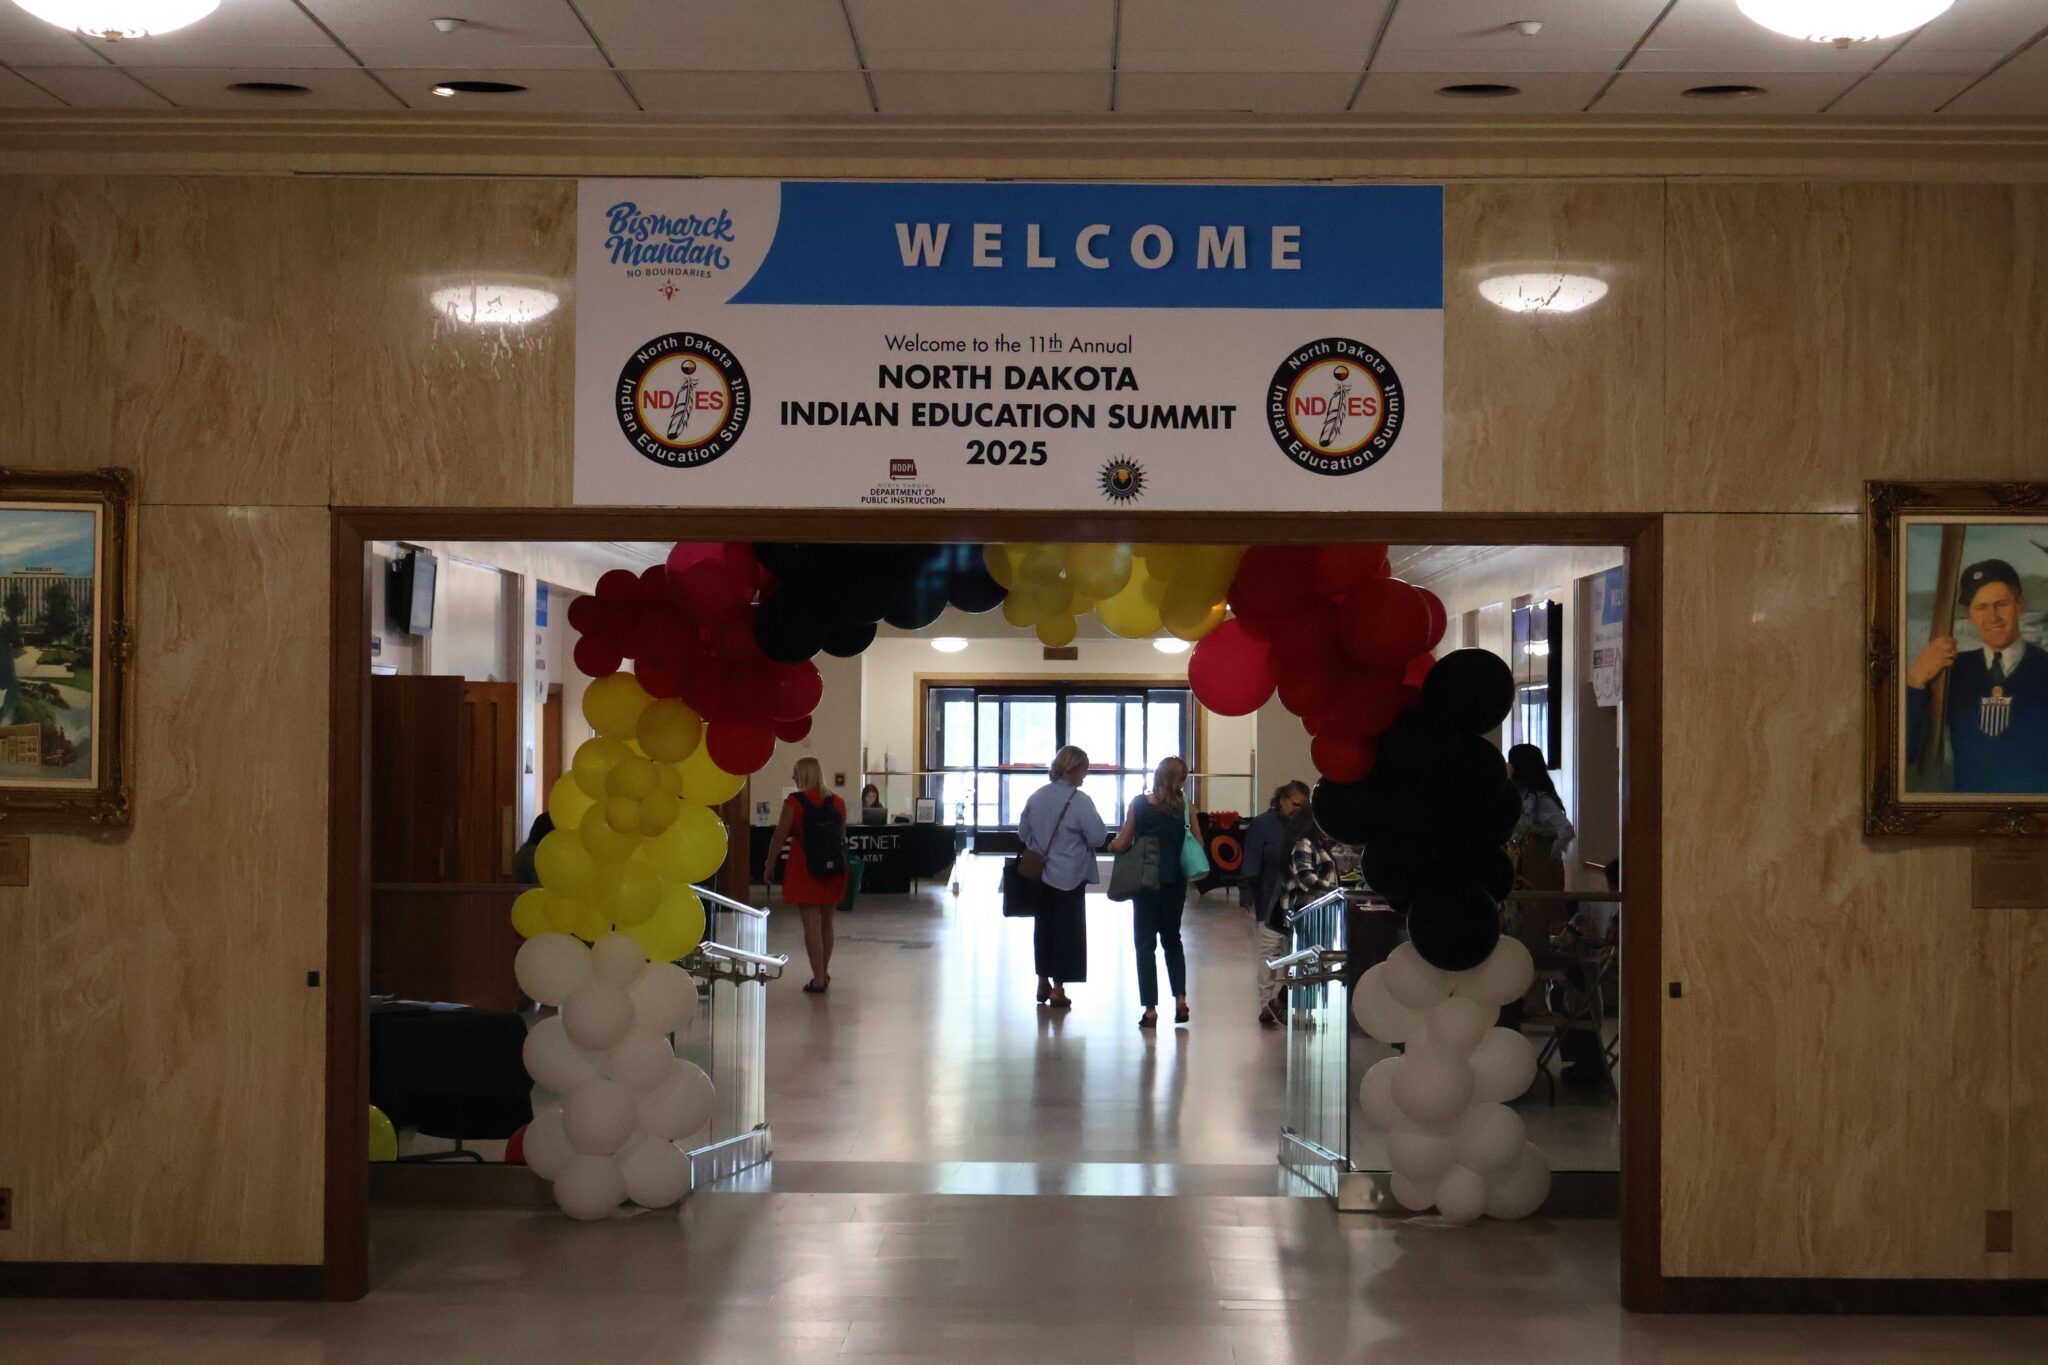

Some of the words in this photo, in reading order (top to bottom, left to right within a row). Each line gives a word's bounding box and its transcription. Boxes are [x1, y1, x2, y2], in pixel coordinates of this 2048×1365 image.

[605, 201, 735, 242] Bismarck
[604, 235, 731, 270] Mandan
[894, 222, 1302, 270] WELCOME
[627, 269, 642, 278] NO
[645, 268, 712, 278] BOUNDARIES
[636, 336, 678, 363] North
[684, 336, 732, 368] Dakota
[885, 335, 966, 353] Welcome
[972, 338, 989, 353] to
[995, 335, 1021, 353] the
[1029, 335, 1062, 353] 11th
[1068, 335, 1133, 354] Annual
[1288, 342, 1330, 370] North
[1336, 341, 1386, 374] Dakota
[878, 365, 992, 390] NORTH
[1004, 365, 1140, 392] DAKOTA
[621, 378, 638, 432] Indian
[636, 433, 720, 463] Education
[719, 377, 745, 442] Summit
[780, 401, 899, 427] INDIAN
[911, 402, 1096, 428] EDUCATION
[1108, 404, 1237, 430] SUMMIT
[1272, 384, 1290, 440] Indian
[1288, 440, 1374, 470] Education
[1373, 383, 1399, 449] Summit
[966, 440, 1048, 466] 2025
[861, 496, 888, 504] PUBLIC
[891, 496, 946, 505] INSTRUCTION
[870, 488, 922, 496] DEPARTMENT
[924, 488, 936, 496] OF
